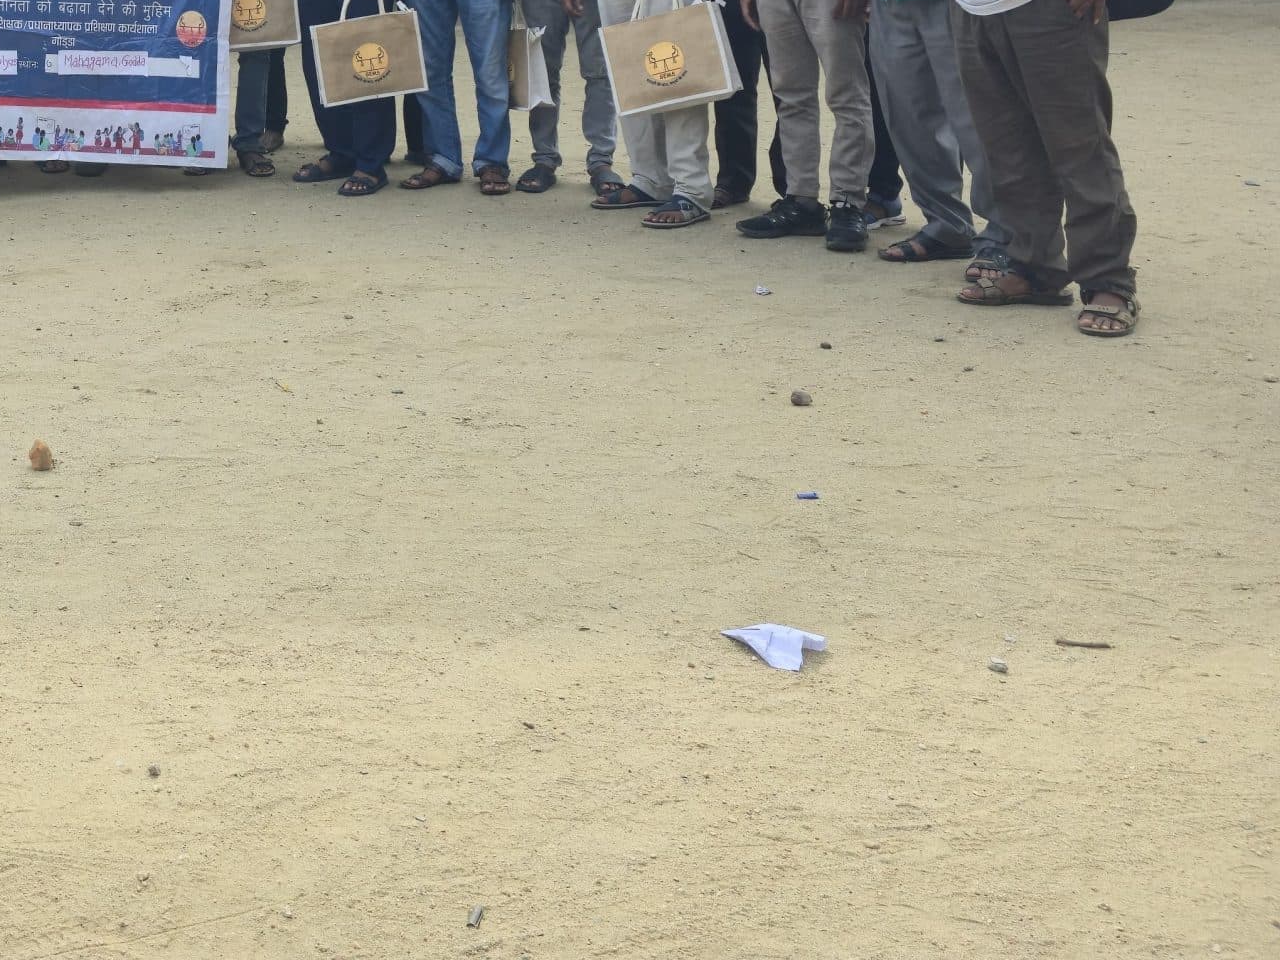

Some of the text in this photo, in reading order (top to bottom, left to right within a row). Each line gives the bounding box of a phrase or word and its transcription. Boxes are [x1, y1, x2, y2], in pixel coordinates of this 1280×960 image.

[97, 0, 115, 15] देने
[122, 1, 137, 16] की
[143, 1, 173, 21] मुहिम
[118, 21, 158, 34] कार्यशाला
